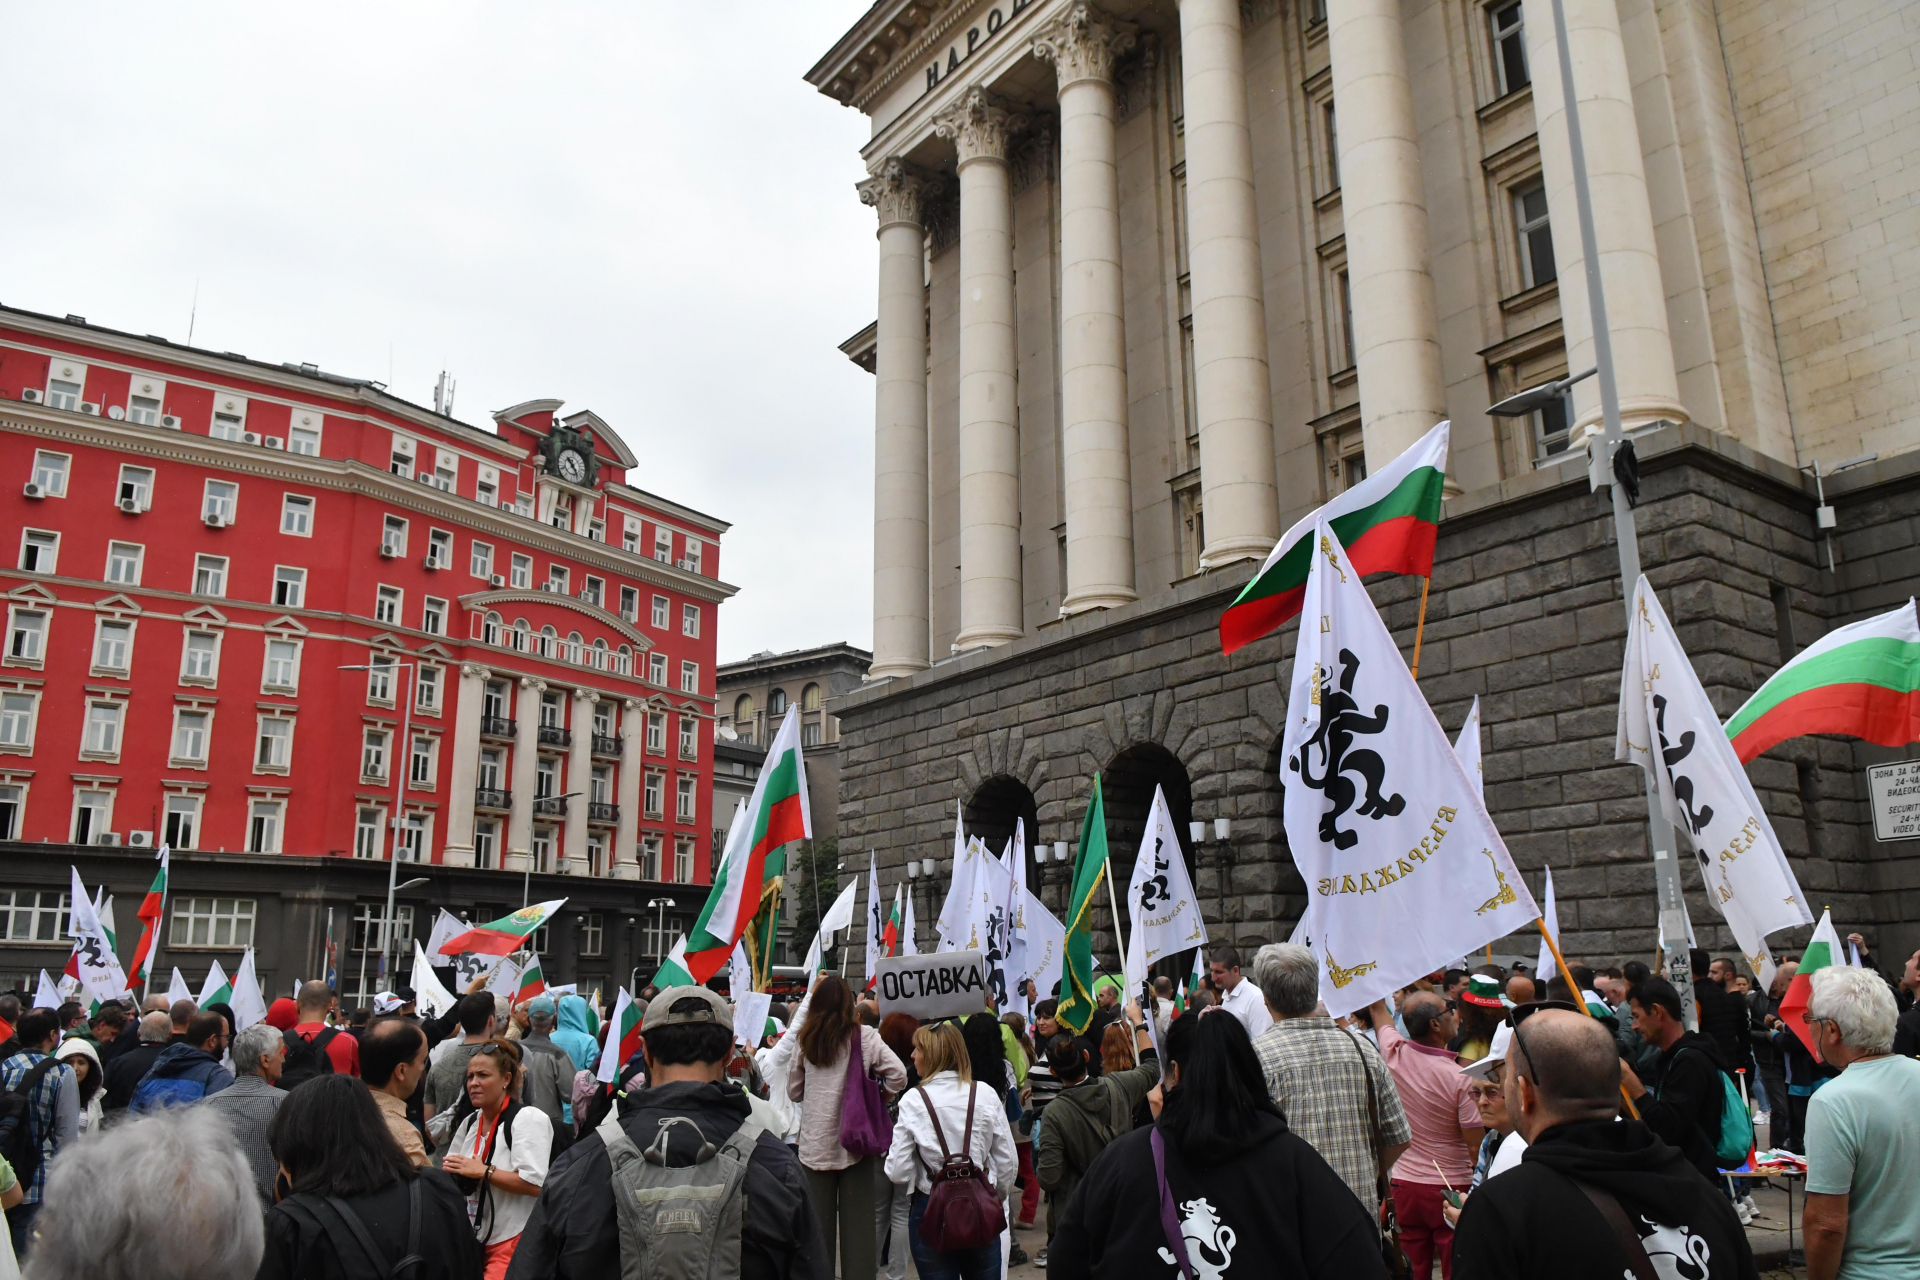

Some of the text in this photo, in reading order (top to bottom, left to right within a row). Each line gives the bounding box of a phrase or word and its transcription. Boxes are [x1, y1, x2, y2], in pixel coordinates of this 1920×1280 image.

[1874, 769, 1893, 779] ЗОНА
[1897, 767, 1907, 776] ЗА
[1893, 824, 1914, 834] VIDEO
[882, 965, 984, 1001] ОСТАВКА
[656, 1211, 700, 1226] CAMELBAK
